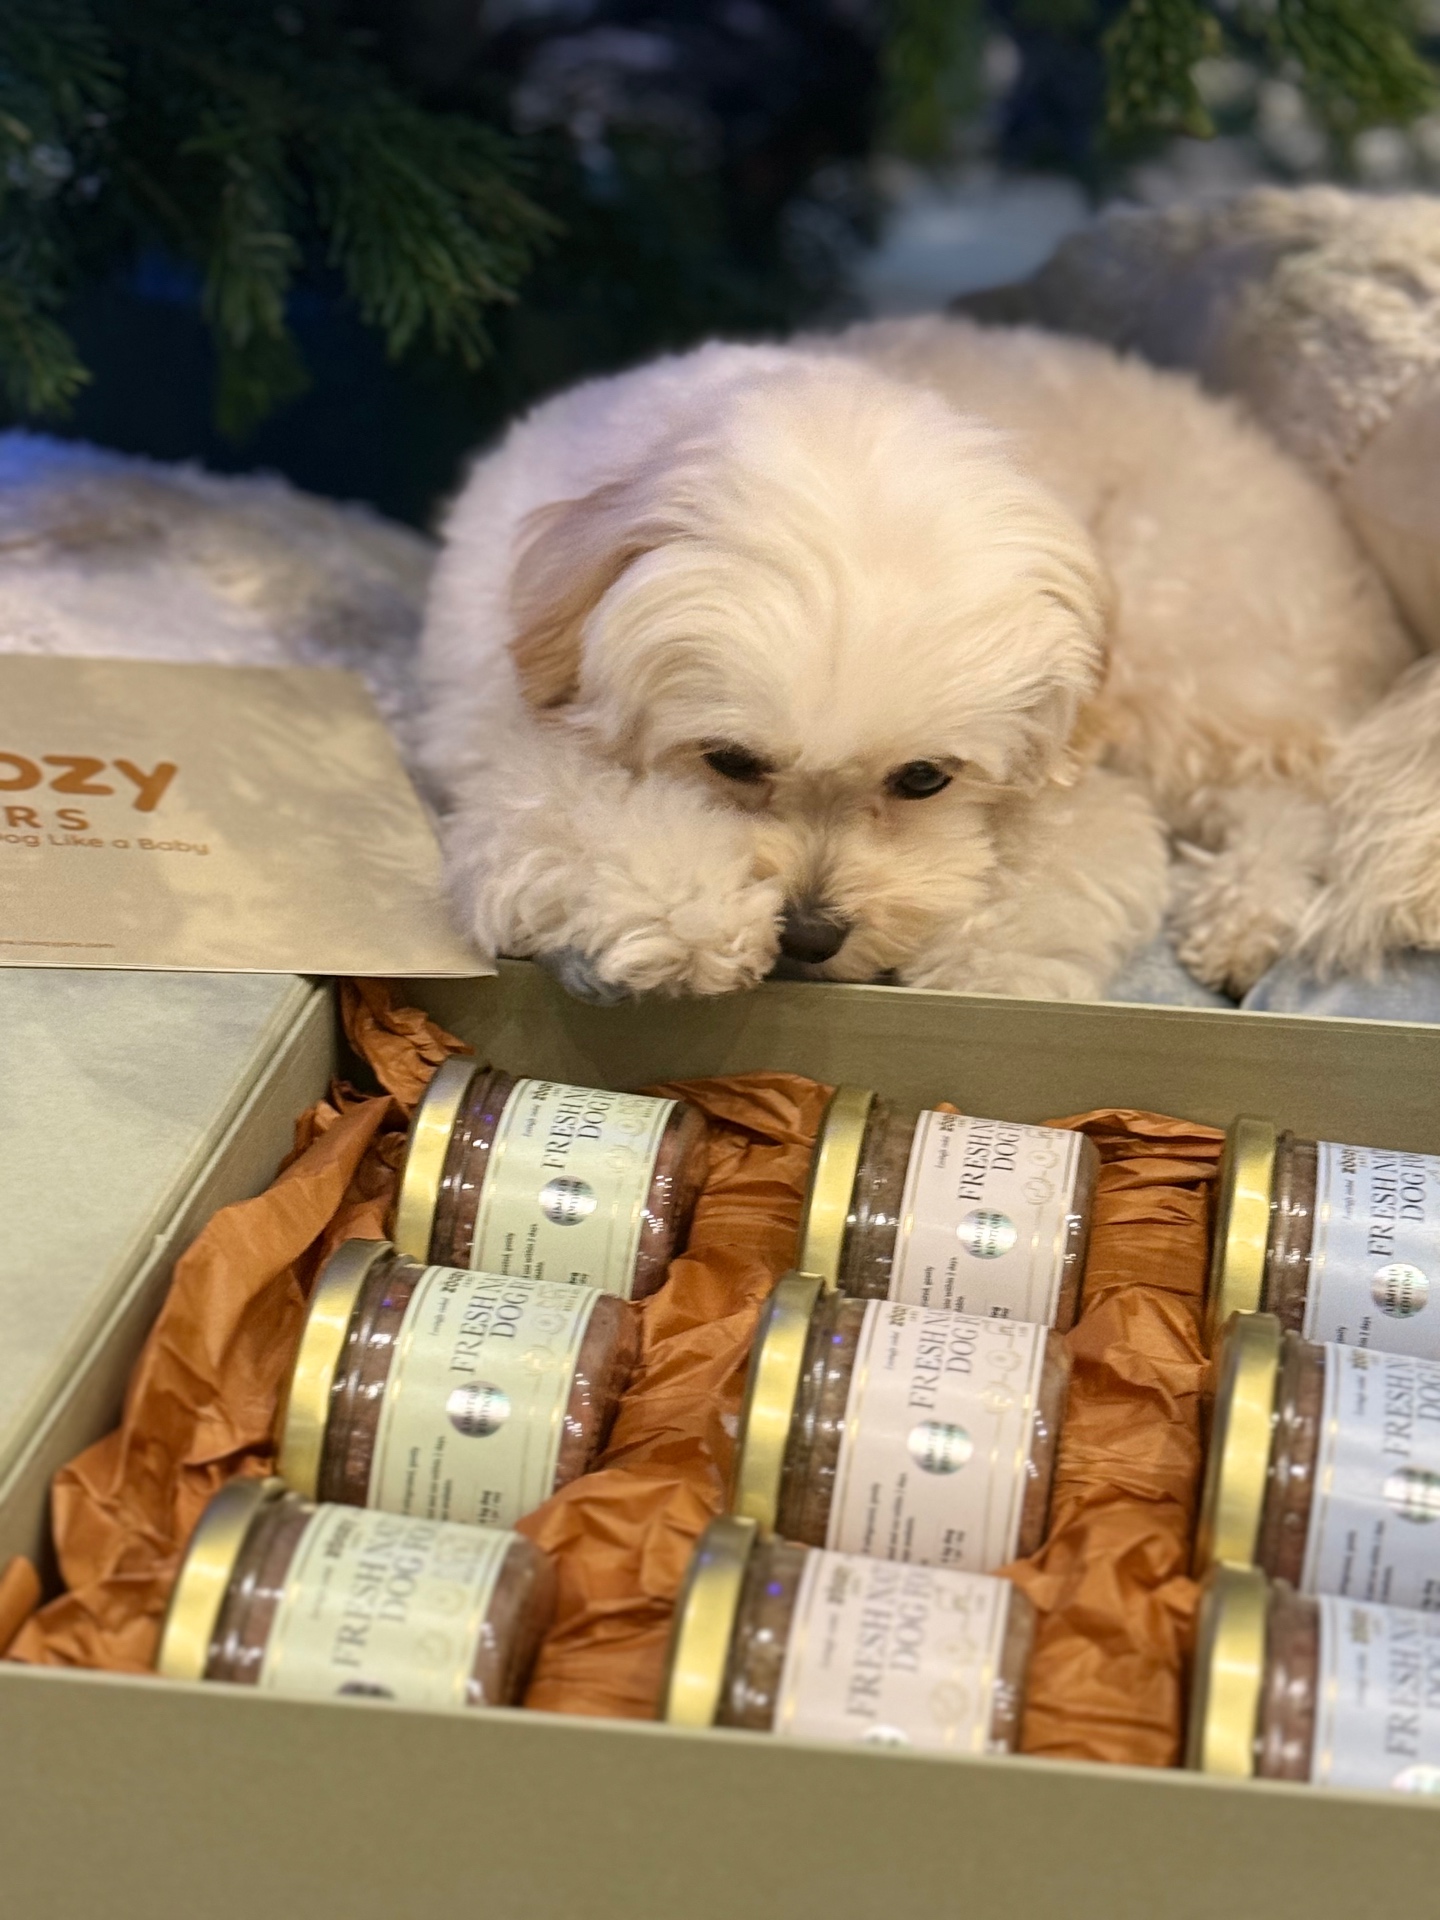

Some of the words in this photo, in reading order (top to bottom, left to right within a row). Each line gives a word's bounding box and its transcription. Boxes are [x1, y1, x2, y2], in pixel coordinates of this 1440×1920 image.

[48, 834, 104, 848] Like
[113, 840, 130, 849] a
[138, 838, 209, 855] Baby
[542, 1102, 581, 1168] FRESH
[577, 1101, 609, 1138] DOG
[992, 1133, 1019, 1169] DOG
[957, 1135, 990, 1199] FRESH
[1399, 1173, 1425, 1220] DOG
[1367, 1178, 1397, 1255] FRESH
[450, 1295, 497, 1373] FRESH
[490, 1292, 528, 1337] DOG
[909, 1331, 945, 1408] FRESH
[947, 1328, 978, 1372] DOG
[1382, 1375, 1413, 1455] FRESH
[332, 1562, 387, 1666] FRESH
[381, 1556, 422, 1620] DOG
[848, 1609, 894, 1716] FRESH
[892, 1604, 928, 1670] DOG
